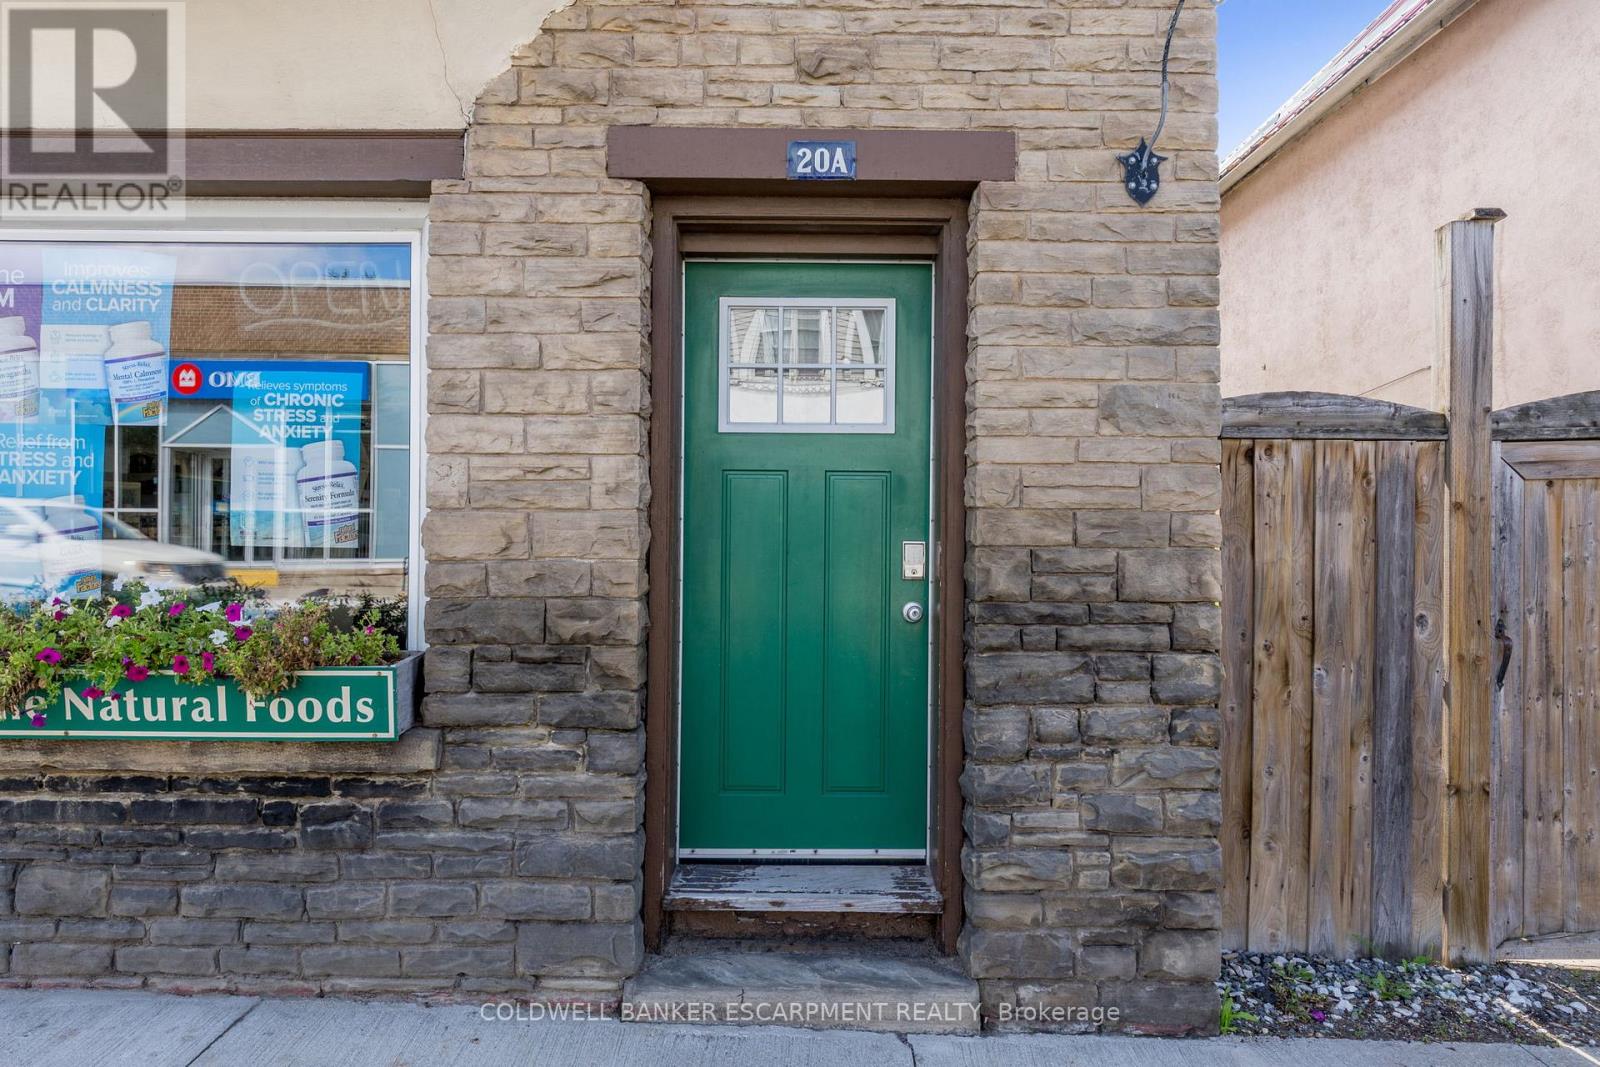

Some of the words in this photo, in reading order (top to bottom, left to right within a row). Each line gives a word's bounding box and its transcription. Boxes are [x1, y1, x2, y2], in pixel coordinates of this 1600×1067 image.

[796, 147, 848, 173] 20A
[63, 262, 150, 282] Improves
[52, 279, 162, 297] CALMNESS
[239, 260, 404, 318] OPEN
[52, 298, 81, 312] and
[86, 298, 161, 312] CLARITY
[293, 382, 348, 394] symptoms
[249, 398, 261, 406] of
[263, 392, 345, 407] CHRONIC
[253, 408, 316, 423] STRESS
[319, 415, 340, 423] and
[259, 424, 333, 439] ANXIETY
[47, 434, 86, 450] from
[61, 452, 94, 468] and
[0, 468, 82, 485] ANXIETY
[63, 685, 227, 723] Natural
[245, 685, 375, 723] Foods
